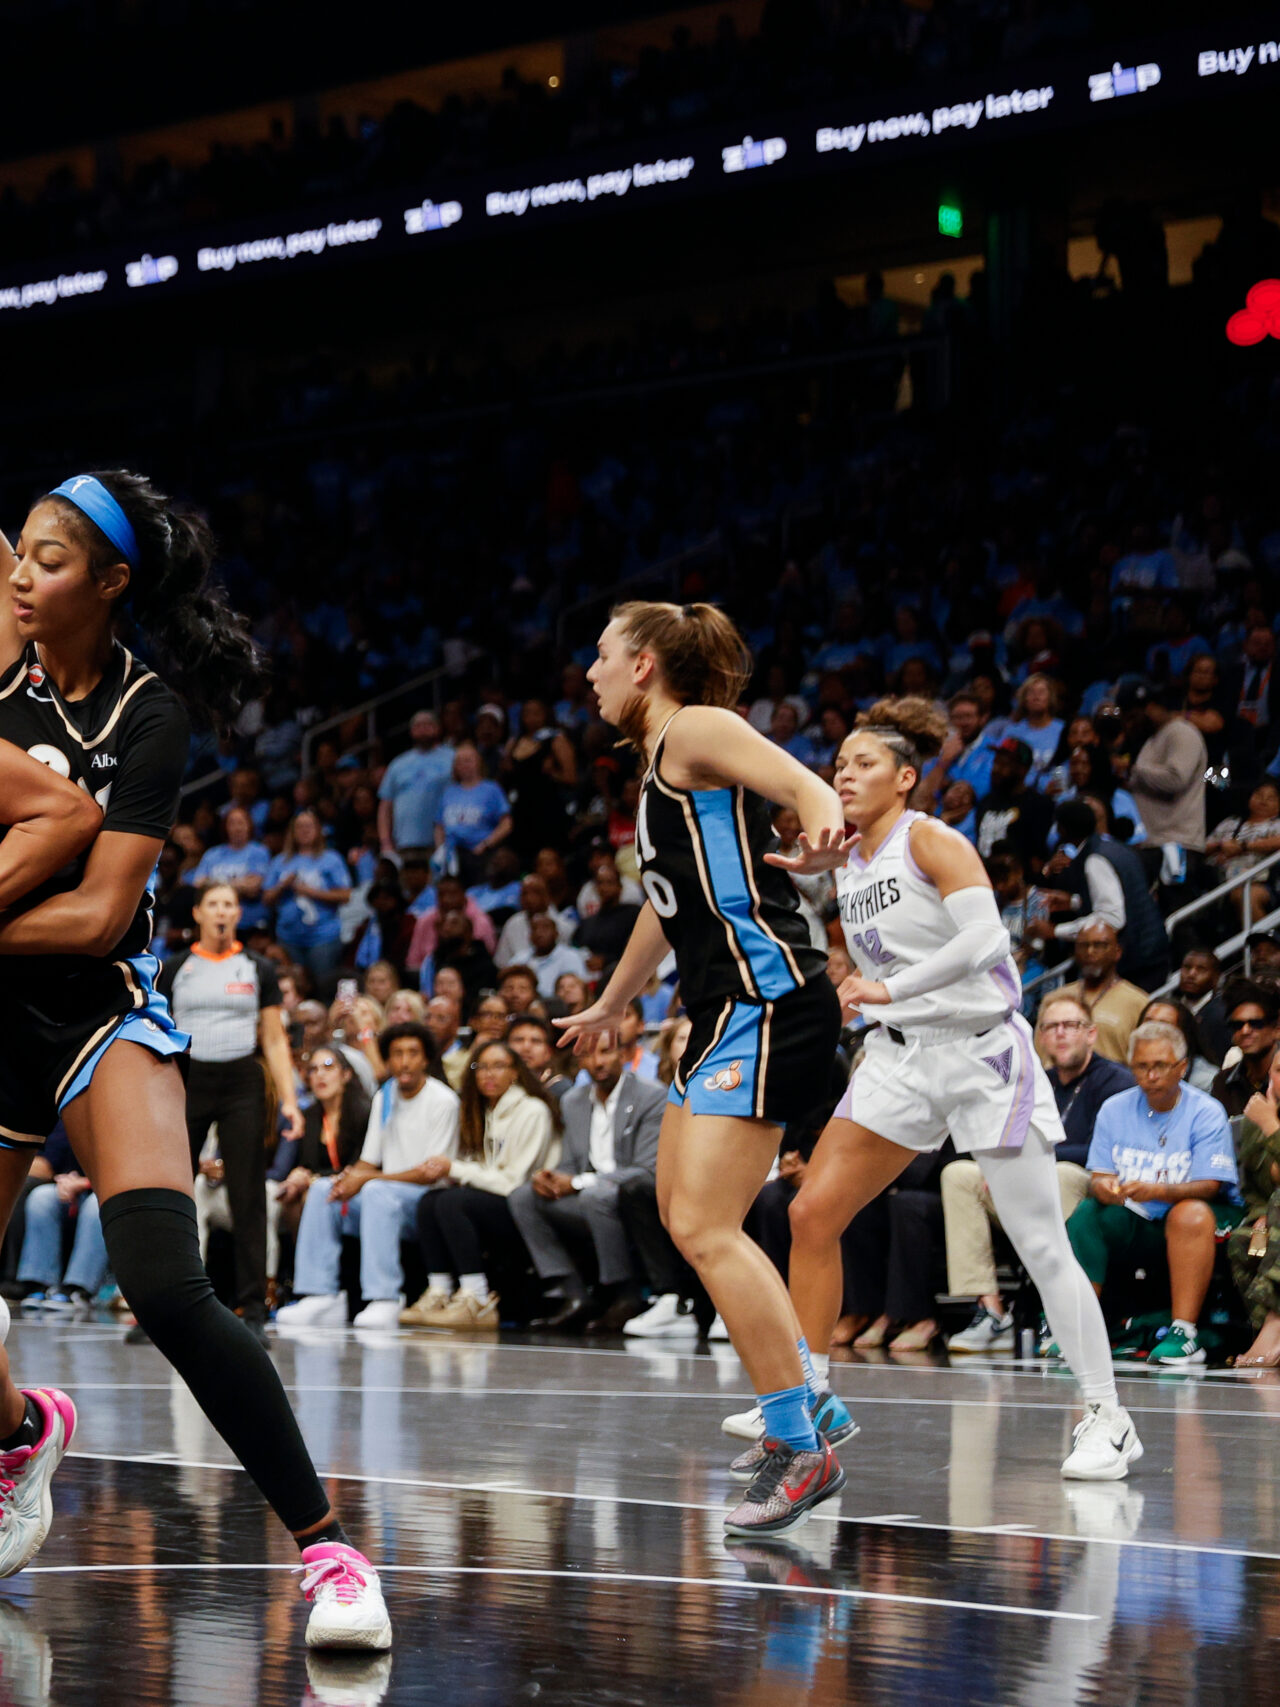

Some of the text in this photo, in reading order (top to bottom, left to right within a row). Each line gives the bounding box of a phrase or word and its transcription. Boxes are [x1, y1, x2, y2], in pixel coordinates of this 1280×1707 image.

[1198, 45, 1255, 77] Buy
[838, 877, 901, 924] ALKYRIES
[853, 927, 897, 967] 12
